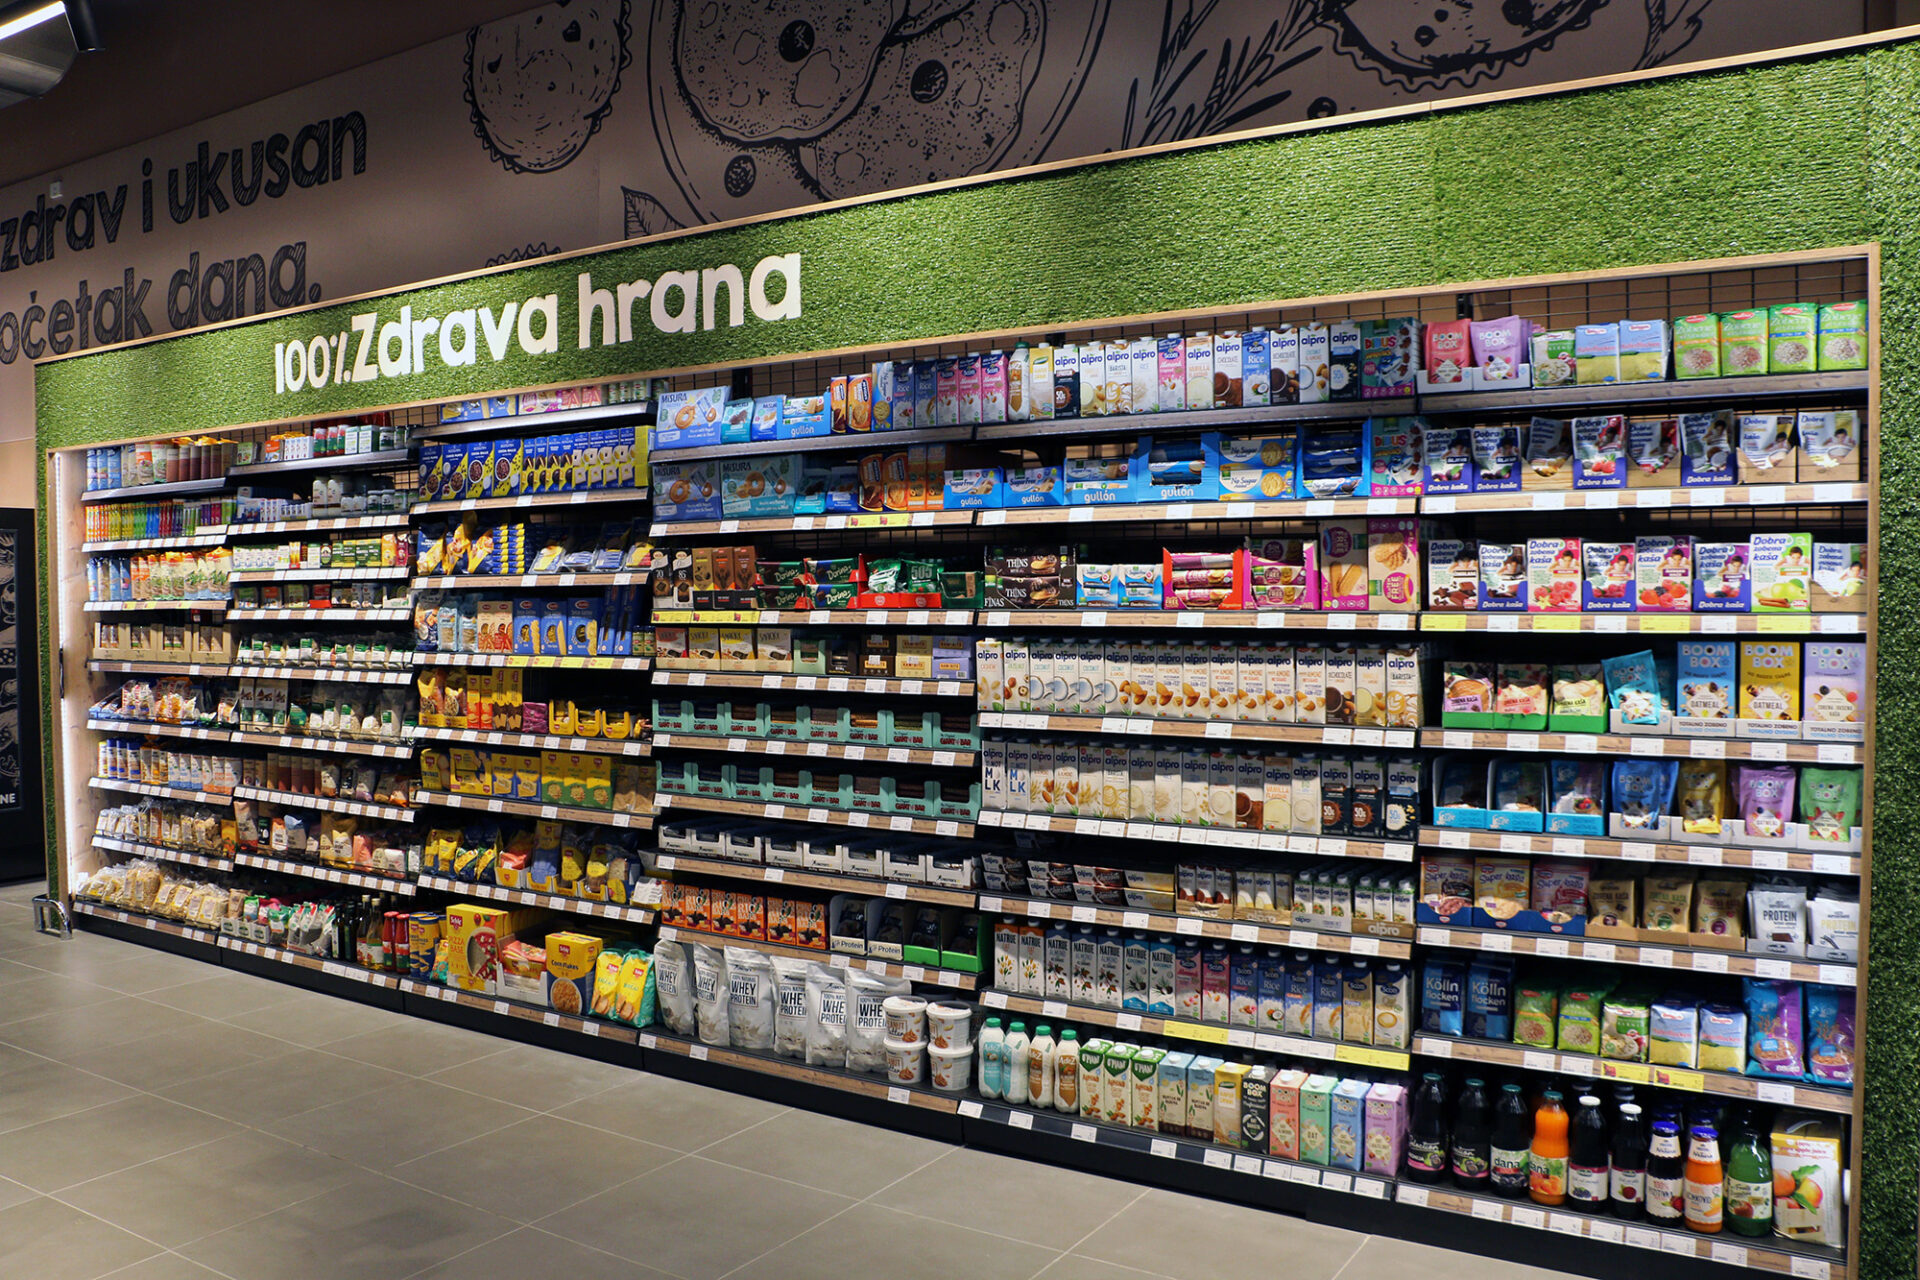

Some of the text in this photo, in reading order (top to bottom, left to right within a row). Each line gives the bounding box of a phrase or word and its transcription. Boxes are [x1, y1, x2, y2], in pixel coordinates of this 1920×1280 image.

[0, 111, 367, 272] zdrav i ukusan
[168, 241, 322, 330] dana.
[350, 294, 559, 383] Zdrava
[579, 252, 801, 350] hrana
[1333, 333, 1358, 344] alpro
[1431, 332, 1463, 342] BOOM
[1479, 329, 1512, 340] BOOM
[1272, 339, 1296, 350] alpro
[1301, 335, 1325, 346] alpro
[1437, 340, 1457, 349] BOX
[1485, 337, 1507, 347] BOX
[1216, 343, 1240, 354] alpro
[1080, 354, 1103, 365] alpro
[1106, 351, 1130, 362] alpro
[1132, 349, 1155, 360] alpro
[1187, 349, 1211, 360] alpro
[1055, 356, 1077, 367] alpro
[1574, 418, 1602, 428] Dobra
[1426, 431, 1452, 440] Dobra
[1473, 430, 1500, 439] Dobra
[1241, 477, 1258, 487] Sugar
[1084, 488, 1116, 503] gullón
[1430, 541, 1459, 551] Dobra
[1530, 540, 1559, 549] Dobra
[1637, 538, 1669, 548] Dobra
[1753, 536, 1786, 545] Dobra
[1698, 545, 1729, 555] Dobra
[1530, 555, 1552, 564] kaša
[1637, 554, 1661, 563] kaša
[1753, 552, 1778, 562] kaša
[1482, 600, 1505, 609] Dobra
[1586, 600, 1610, 609] Dobra
[1698, 600, 1723, 609] Dobra
[978, 650, 998, 661] alpro
[1005, 649, 1026, 661] alpro
[1031, 650, 1053, 661] alpro
[1055, 650, 1077, 662] alpro
[1682, 644, 1730, 657] BOOM
[1744, 644, 1793, 657] BOOM
[1811, 645, 1861, 658] BOOM
[1080, 651, 1103, 662] alpro
[1107, 651, 1129, 662] alpro
[1133, 652, 1155, 663] alpro
[1158, 652, 1181, 663] alpro
[1185, 652, 1207, 664] alpro
[1211, 655, 1235, 666] alpro
[1239, 655, 1264, 666] alpro
[1267, 655, 1291, 667] alpro
[1298, 656, 1323, 667] alpro
[1328, 656, 1353, 668] alpro
[1358, 657, 1383, 668] alpro
[1388, 657, 1415, 669] alpro
[1690, 656, 1721, 669] BOX
[1752, 657, 1784, 669] BOX
[1818, 658, 1849, 670] BOX
[1690, 699, 1721, 709] OATMEAL
[1753, 701, 1784, 710] OATMEAL
[1756, 788, 1778, 799] BOX
[1762, 910, 1797, 922] PROTEIN
[1368, 921, 1401, 937] alpro
[841, 940, 863, 950] Protein
[877, 944, 900, 954] Protein
[659, 969, 677, 983] WHEY
[658, 981, 677, 994] PROTEIN
[731, 980, 757, 995] WHEY
[1426, 976, 1459, 993] Kölln
[1471, 980, 1506, 997] Kölln
[730, 993, 757, 1006] PROTEIN
[1425, 990, 1459, 1003] flocken
[1471, 994, 1506, 1007] flocken
[1494, 1157, 1520, 1168] dana
